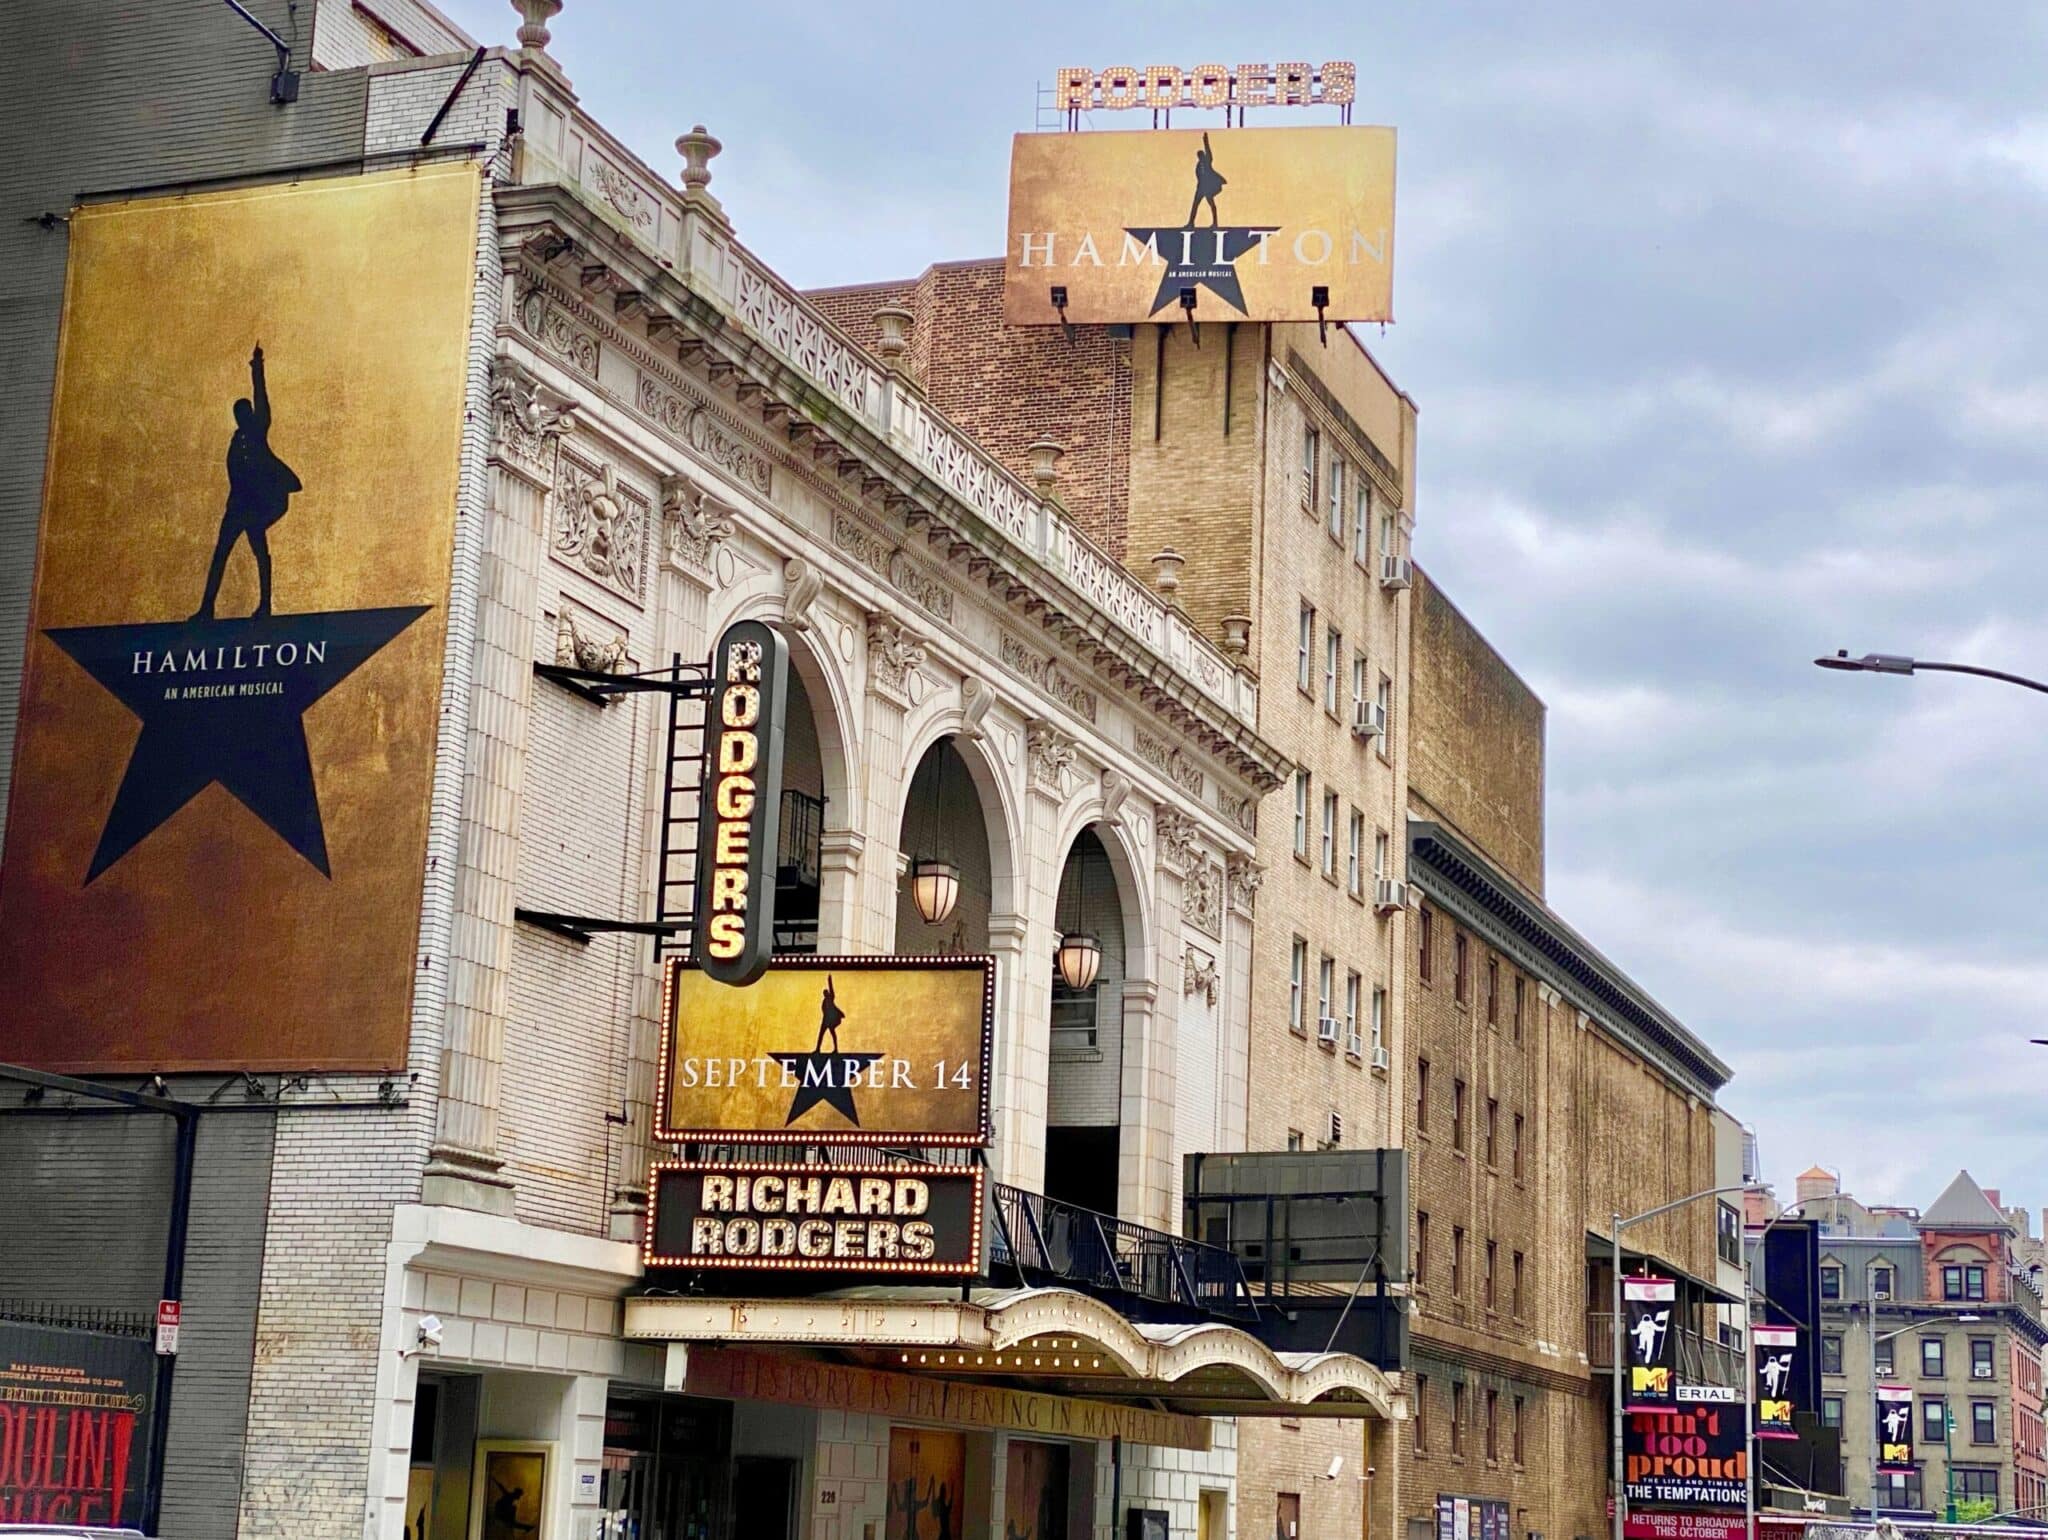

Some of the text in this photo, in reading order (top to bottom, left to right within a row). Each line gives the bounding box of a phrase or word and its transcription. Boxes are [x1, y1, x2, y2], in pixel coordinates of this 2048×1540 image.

[1056, 61, 1356, 111] RODGERS
[1018, 227, 1390, 268] HAMILTON
[131, 640, 327, 675] HAMILTON
[164, 681, 285, 700] AN AMERICAN MUSICAL
[709, 640, 763, 959] RODGERS
[682, 1057, 973, 1091] SEPTEMBER 14
[701, 1175, 930, 1217] RICHARD
[691, 1217, 936, 1260] RODGERS
[1632, 1367, 1673, 1392] MTV
[7, 1387, 43, 1402] BEAUTY
[53, 1390, 97, 1406] FREEDOM
[730, 1356, 1193, 1443] HISTORY IS HAPPENING IN MANHATTAN
[1761, 1400, 1795, 1420] MTV
[1884, 1444, 1911, 1460] MTV
[1628, 1451, 1747, 1483] proud
[1626, 1484, 1748, 1503] THE TEMPTATIONS
[1708, 1480, 1734, 1488] TIMES
[1632, 1513, 1678, 1527] RETURNS
[1679, 1516, 1693, 1526] TO
[1654, 1525, 1729, 1539] THIS OCTOBER!
